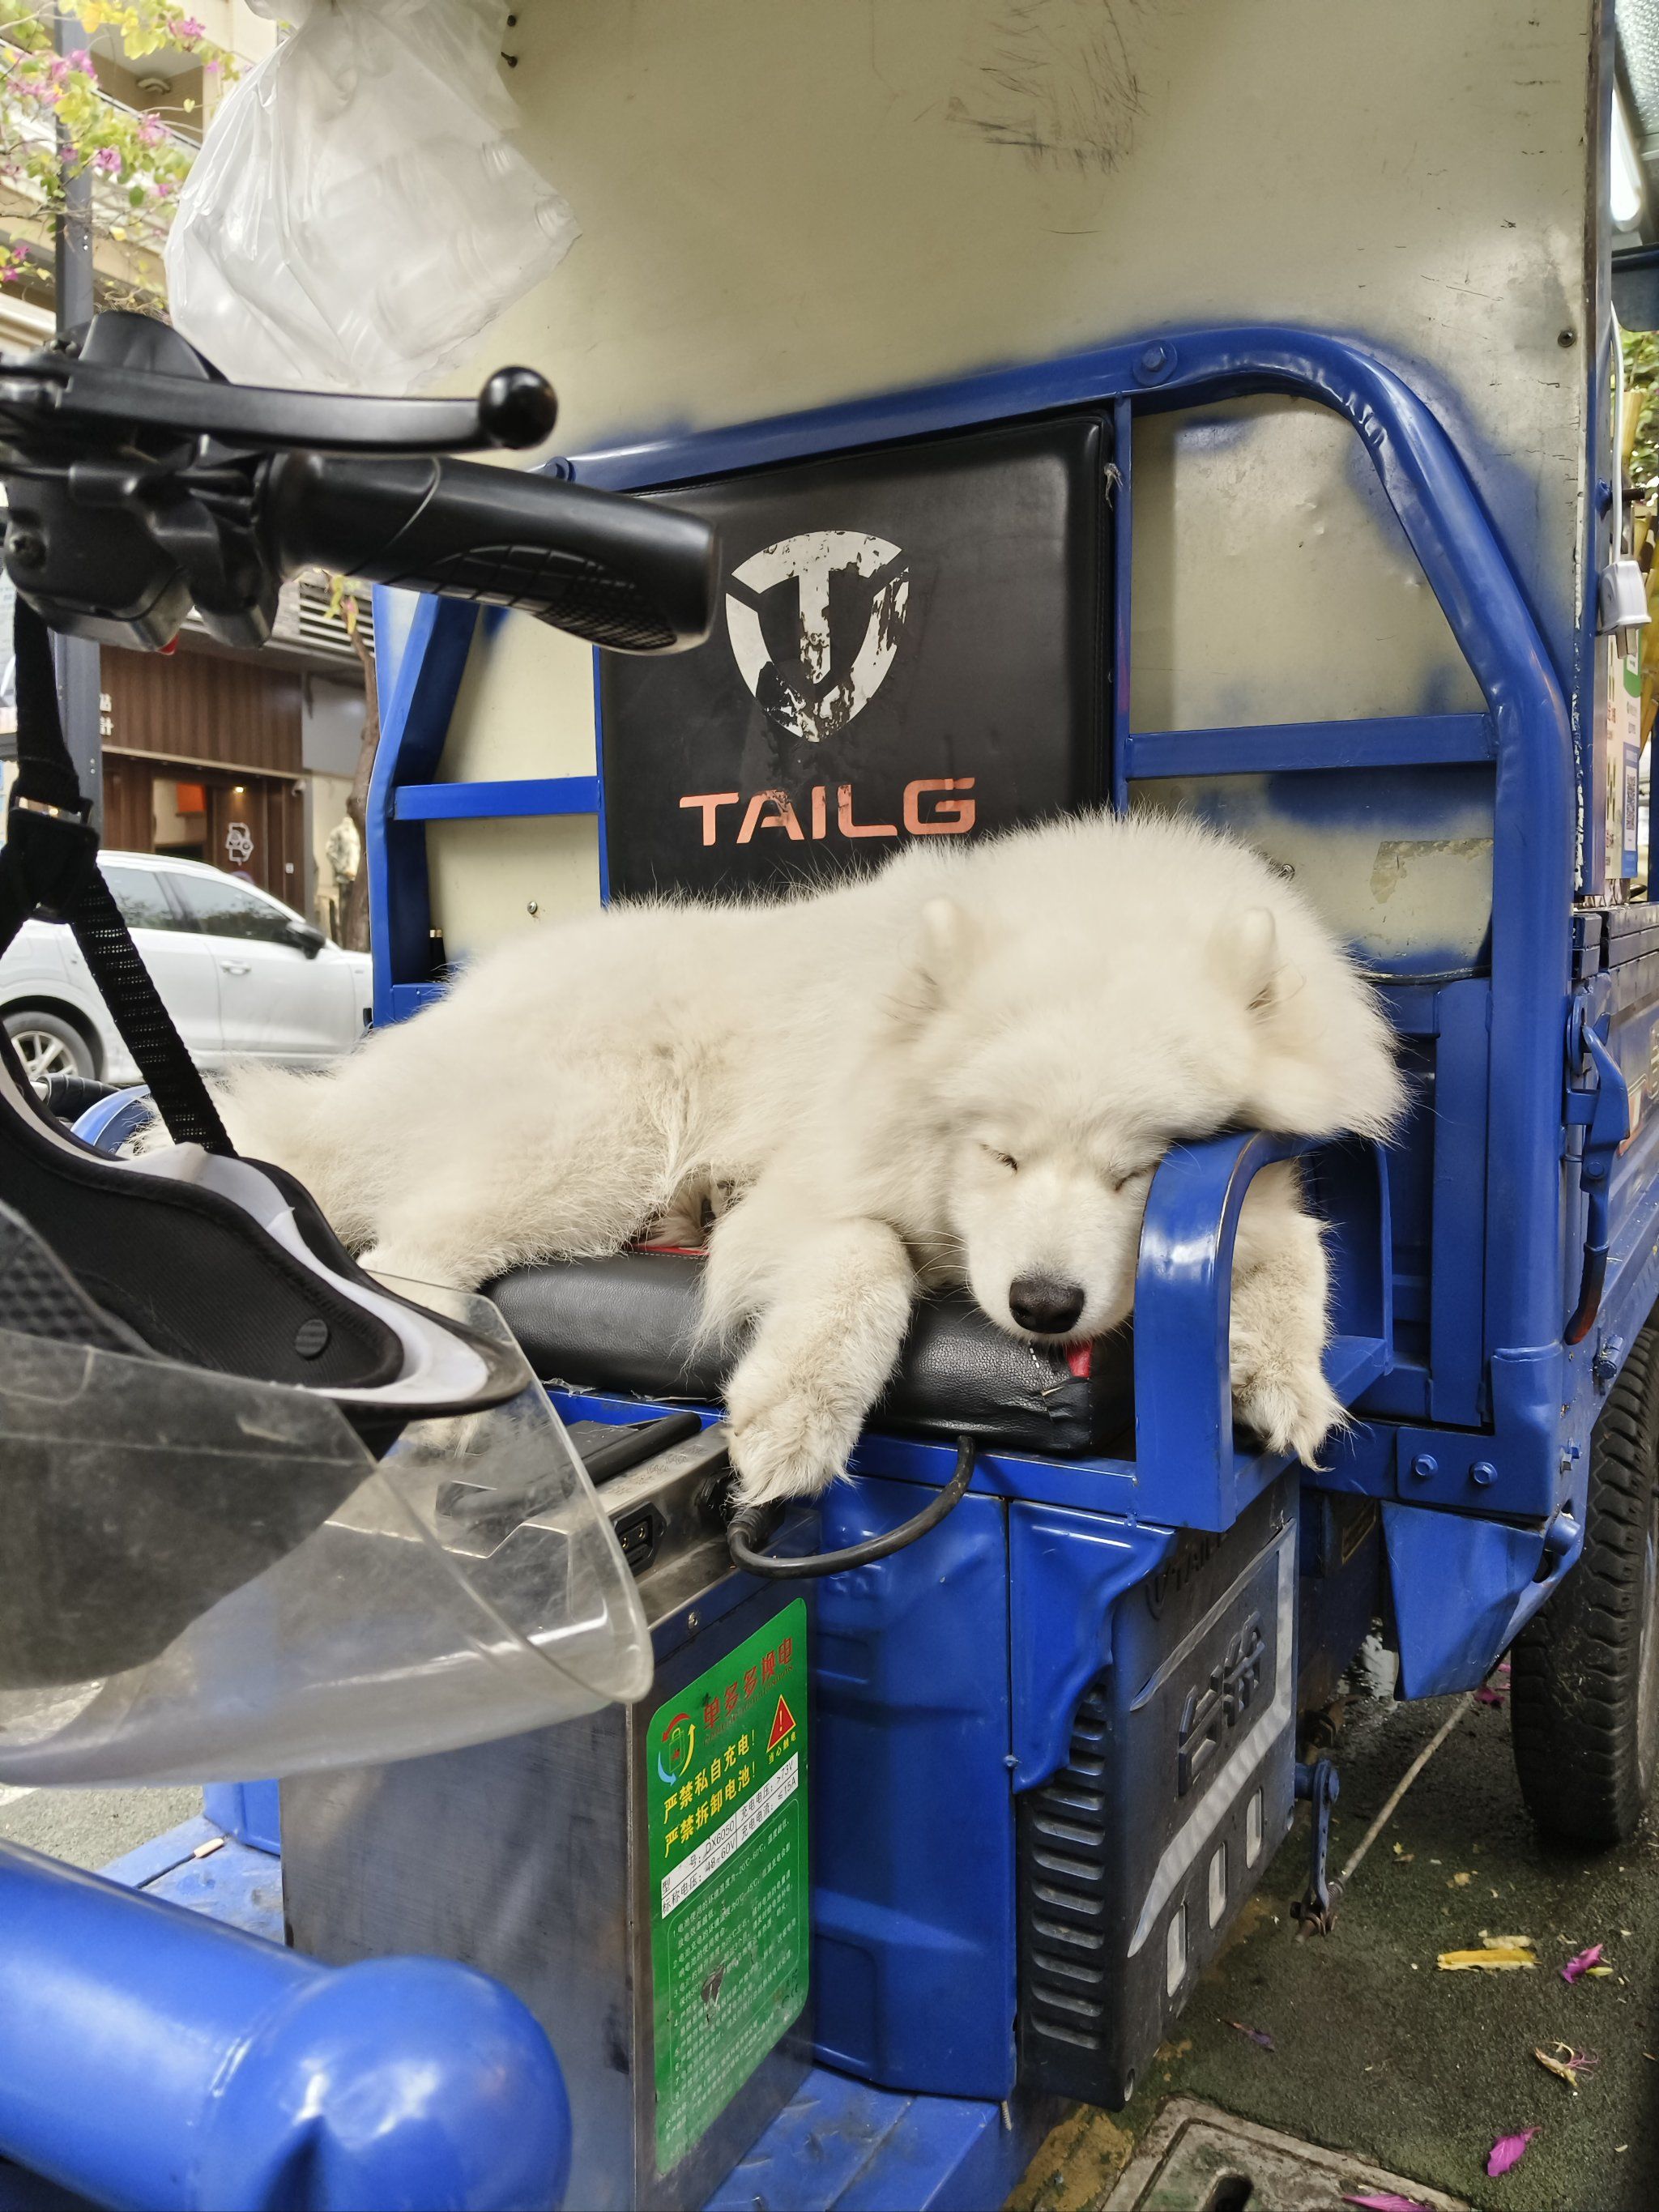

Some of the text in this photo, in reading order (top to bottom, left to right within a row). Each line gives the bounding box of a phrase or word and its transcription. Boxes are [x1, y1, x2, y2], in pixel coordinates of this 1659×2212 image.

[679, 777, 976, 846] TAILG
[664, 1728, 755, 1824] 严禁私自充电！
[664, 1761, 755, 1860] 严禁拆卸电池！
